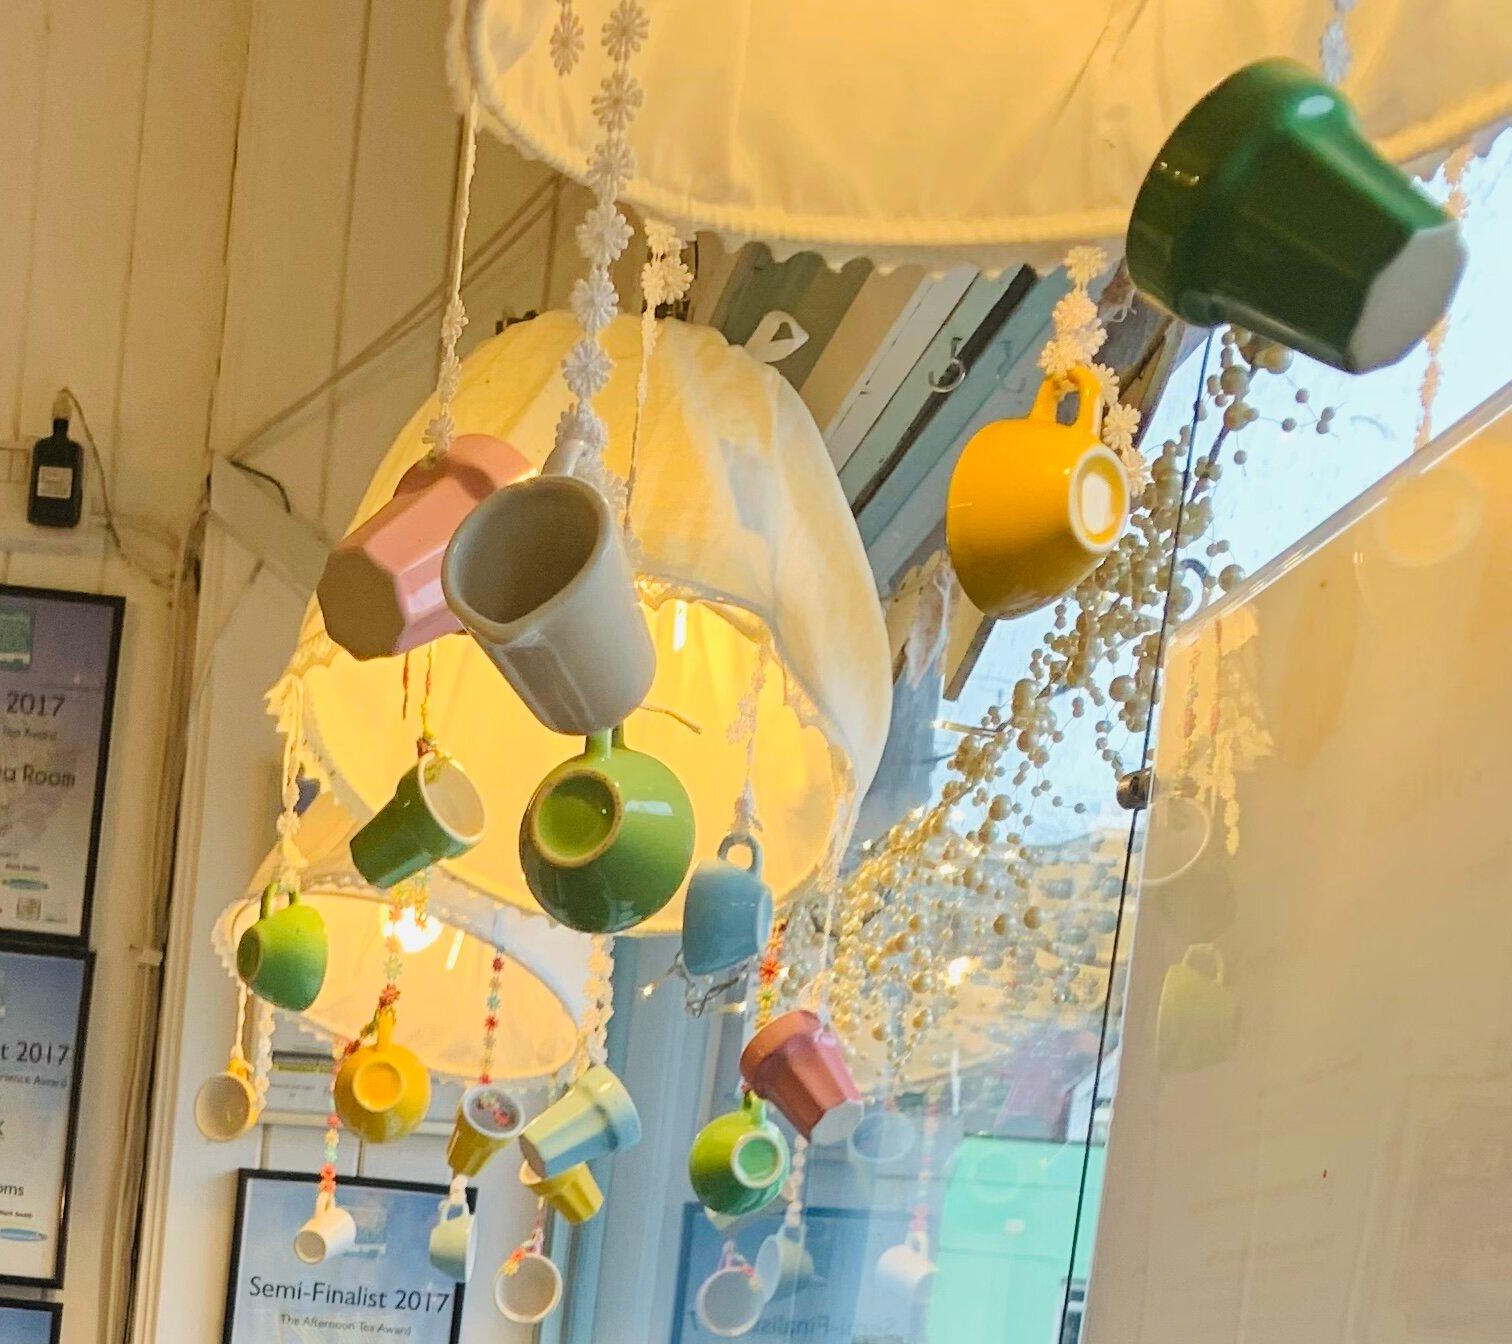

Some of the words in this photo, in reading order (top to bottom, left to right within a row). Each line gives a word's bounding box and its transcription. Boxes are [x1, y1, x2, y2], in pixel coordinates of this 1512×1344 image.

[6, 691, 65, 716] 2017
[23, 764, 76, 788] Room
[16, 1041, 70, 1066] 2017
[250, 1275, 387, 1308] Semi-Finalist
[395, 1290, 449, 1312] 2017
[281, 1314, 300, 1325] The
[303, 1317, 355, 1330] Afternoon
[359, 1321, 375, 1332] Tea
[377, 1322, 411, 1336] Award
